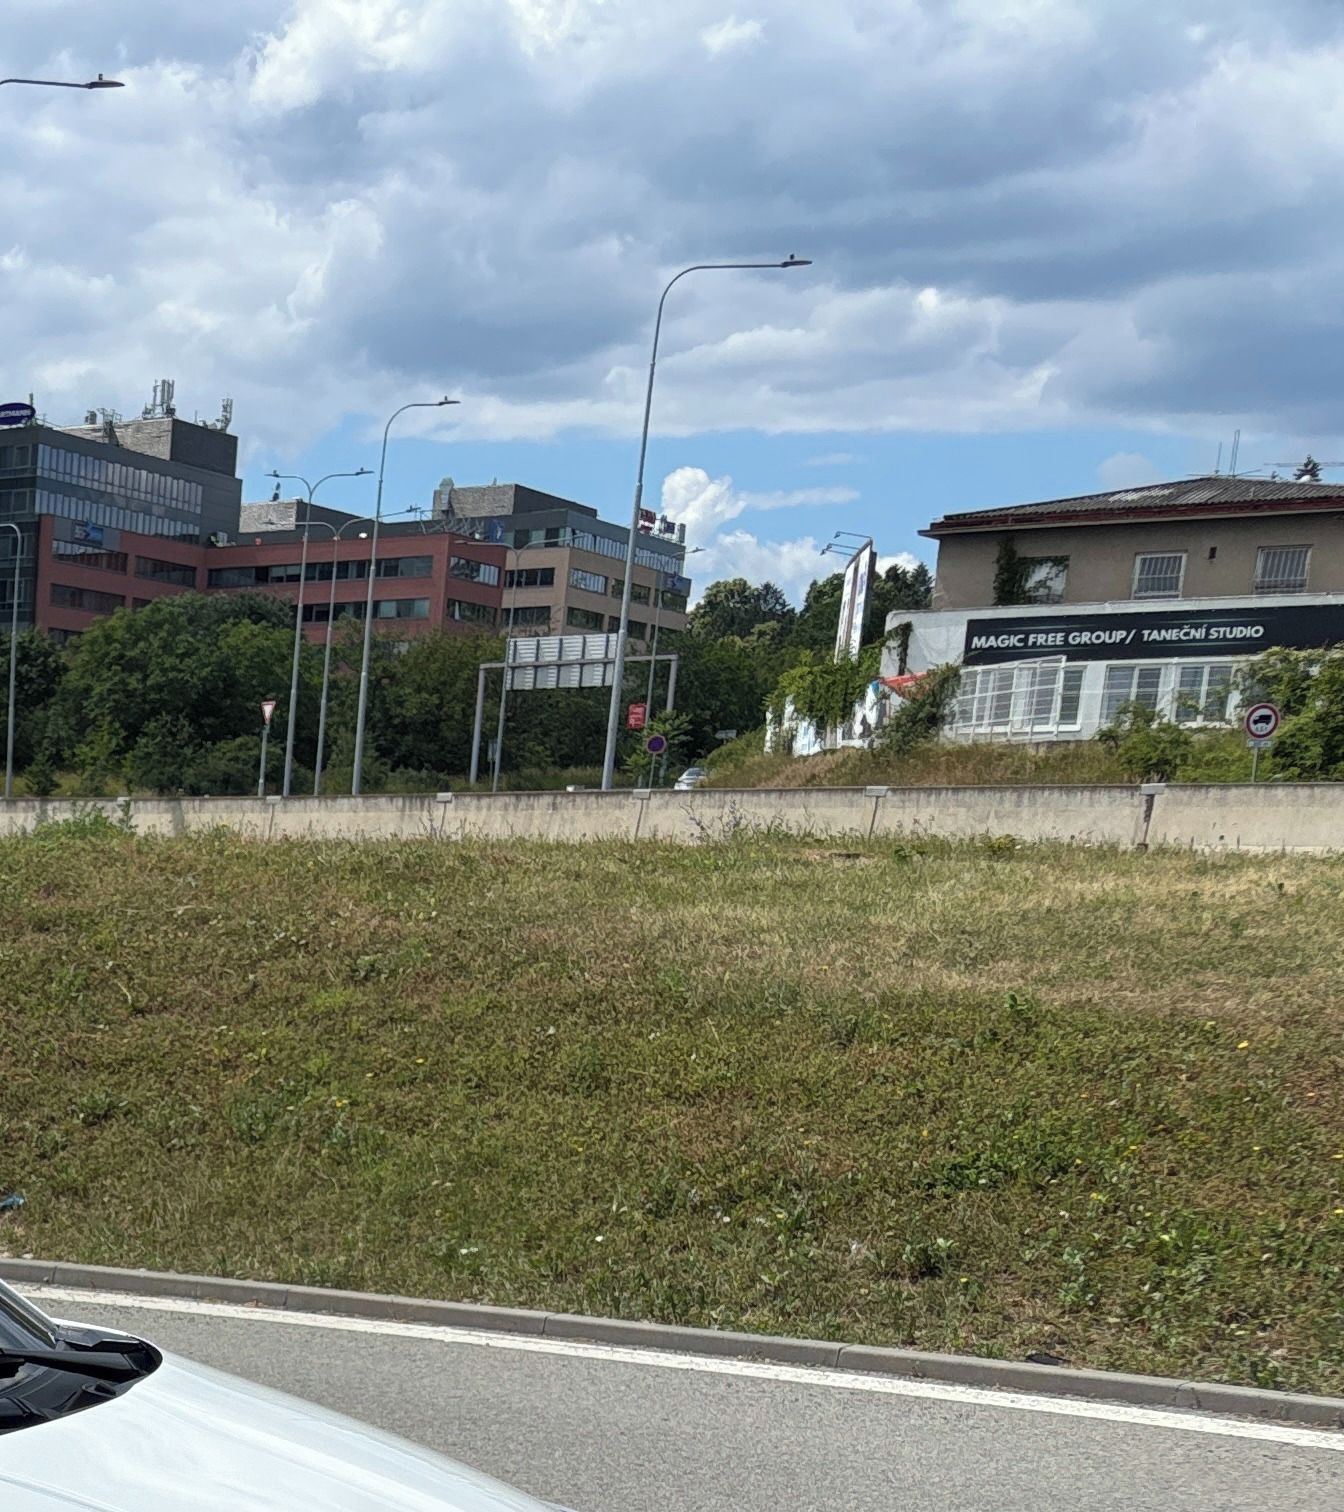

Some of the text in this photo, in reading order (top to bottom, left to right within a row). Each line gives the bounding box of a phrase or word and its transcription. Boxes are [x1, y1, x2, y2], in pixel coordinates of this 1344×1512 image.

[971, 633, 1025, 649] MAGIC
[1028, 632, 1064, 646] FREE
[1142, 624, 1206, 642] TANEČNÍ
[1209, 625, 1265, 640] STUDIO
